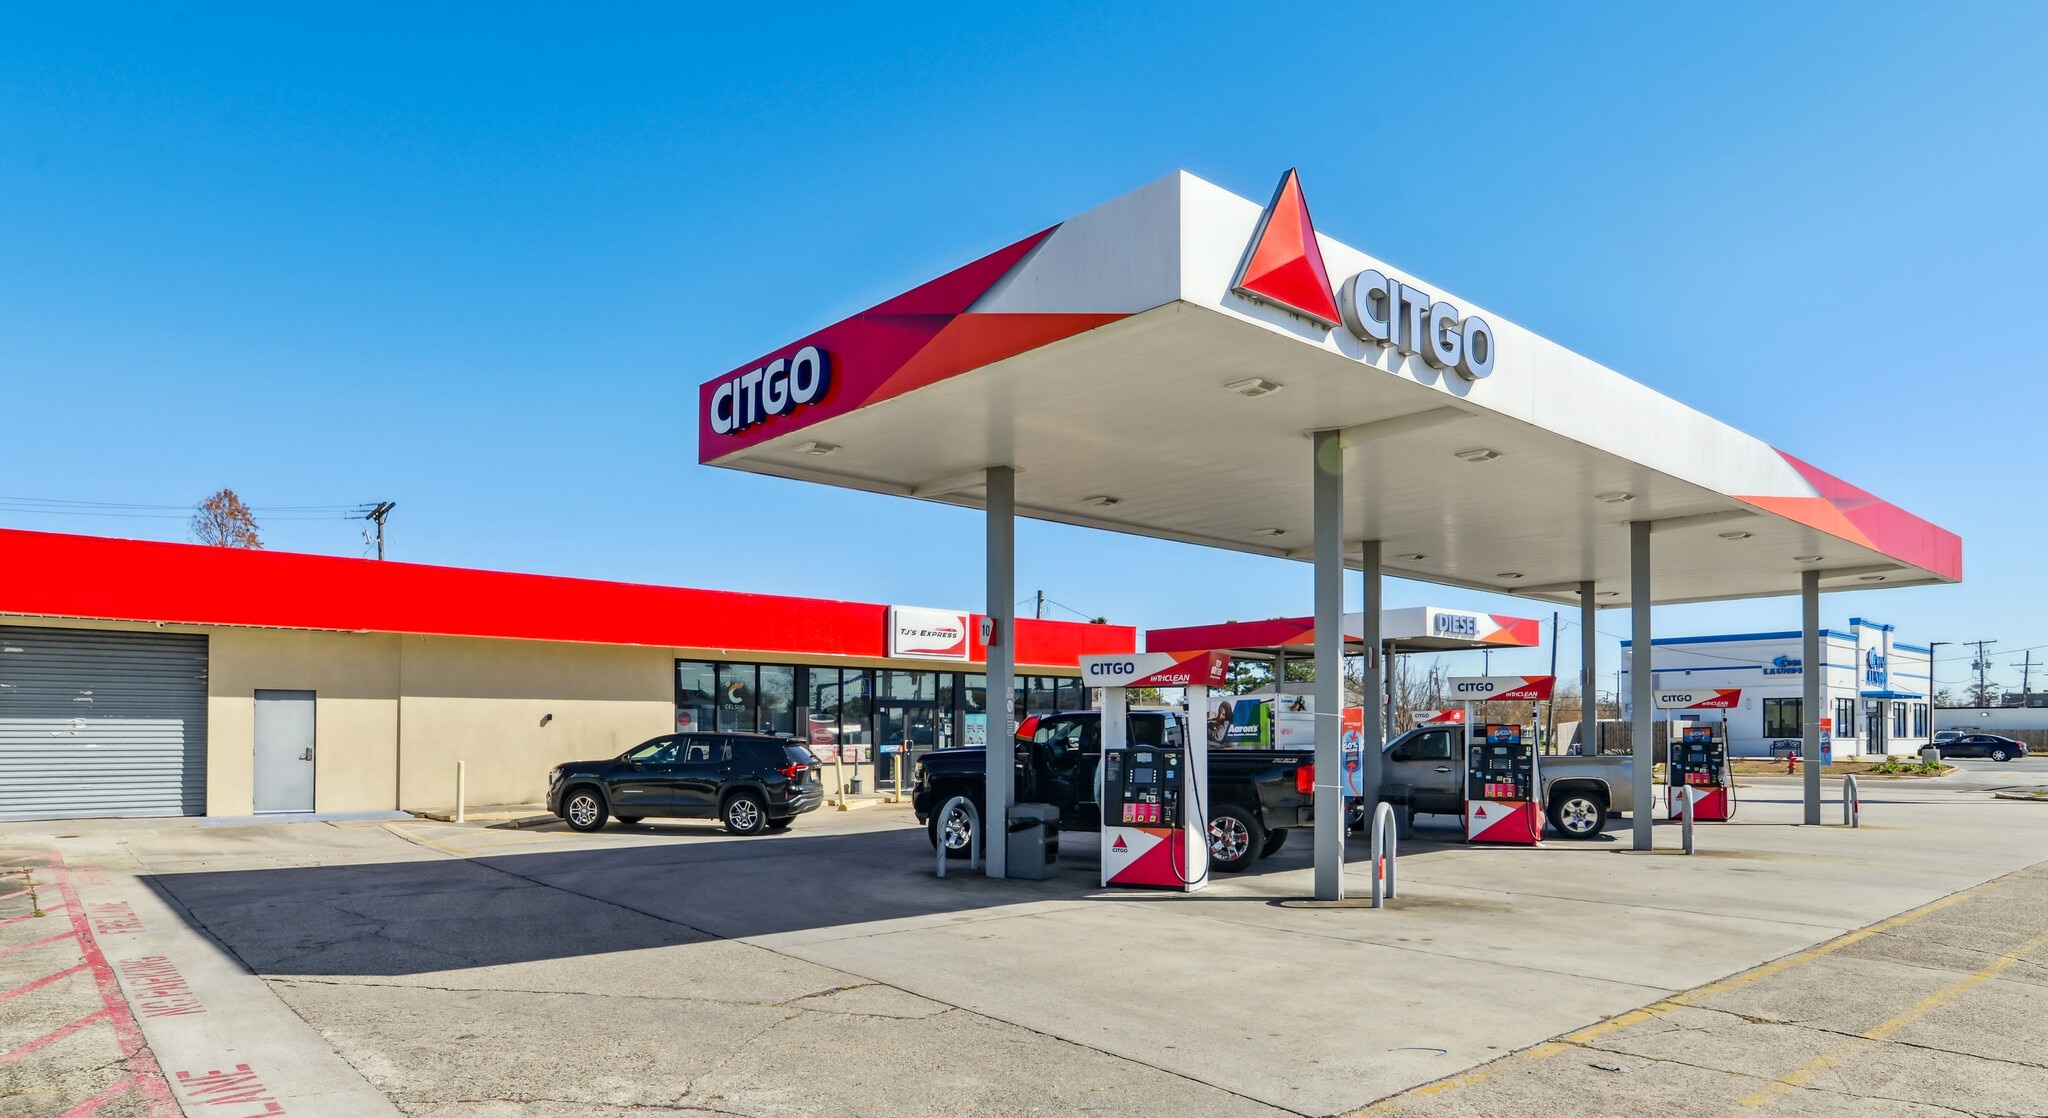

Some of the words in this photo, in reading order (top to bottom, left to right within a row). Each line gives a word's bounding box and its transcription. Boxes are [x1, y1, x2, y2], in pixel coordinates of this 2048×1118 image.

[1348, 268, 1495, 380] CITGO
[709, 345, 823, 435] CITGO
[1437, 612, 1480, 635] DIESEL
[919, 629, 958, 639] EXPRESS
[981, 624, 990, 637] 10
[1090, 661, 1135, 676] CITGO
[1457, 682, 1494, 692] CITGO
[1661, 694, 1692, 702] CITGO
[724, 703, 746, 711] CELSIUS
[1228, 724, 1258, 733] Aaron's
[118, 956, 194, 999] PARKING
